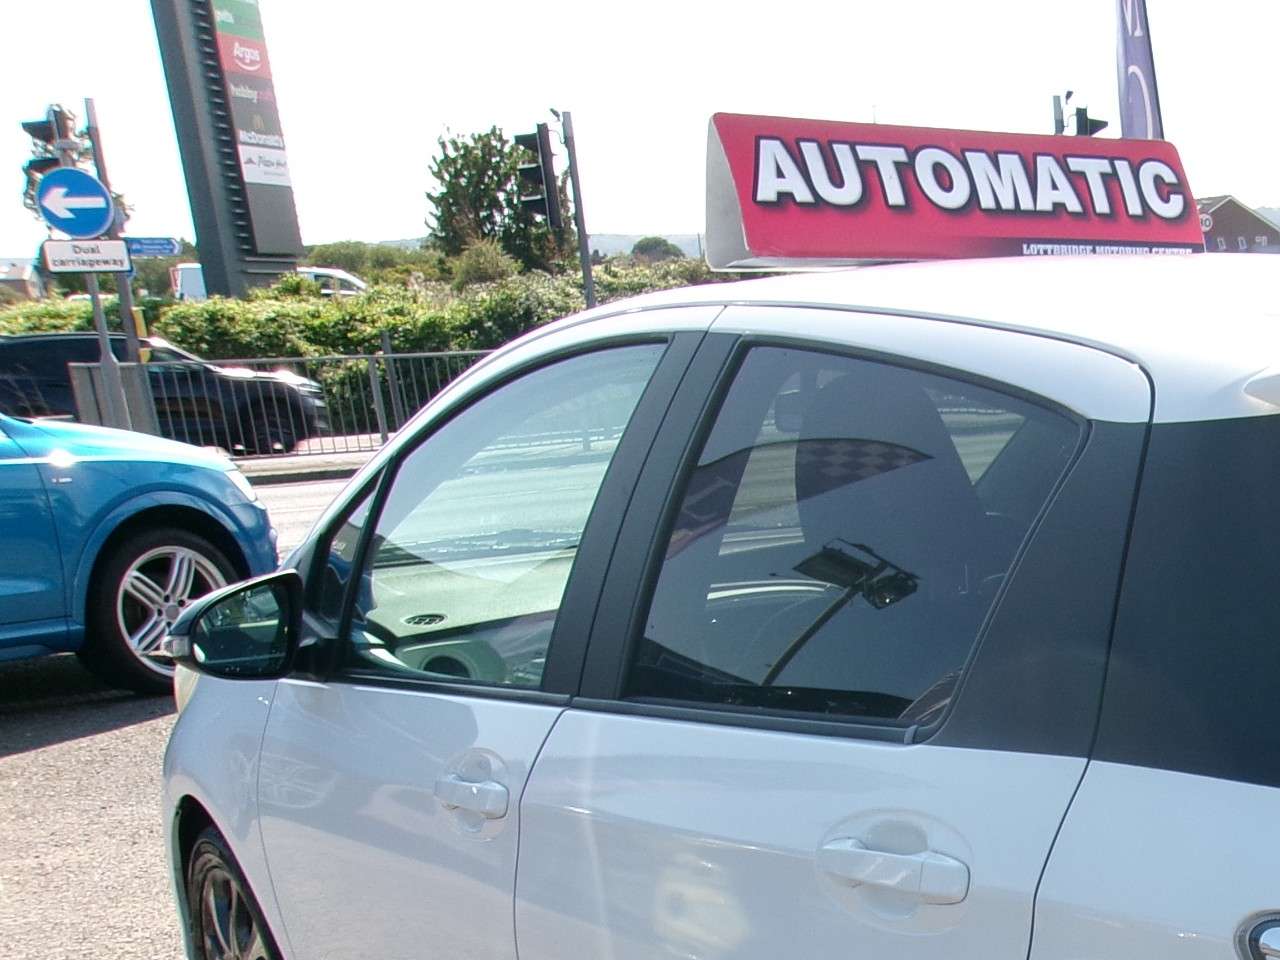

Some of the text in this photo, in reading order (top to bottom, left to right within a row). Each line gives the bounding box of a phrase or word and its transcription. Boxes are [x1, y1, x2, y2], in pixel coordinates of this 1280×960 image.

[756, 138, 1185, 219] AUTOMATIC
[72, 244, 101, 254] Dual
[52, 257, 125, 267] carriageway
